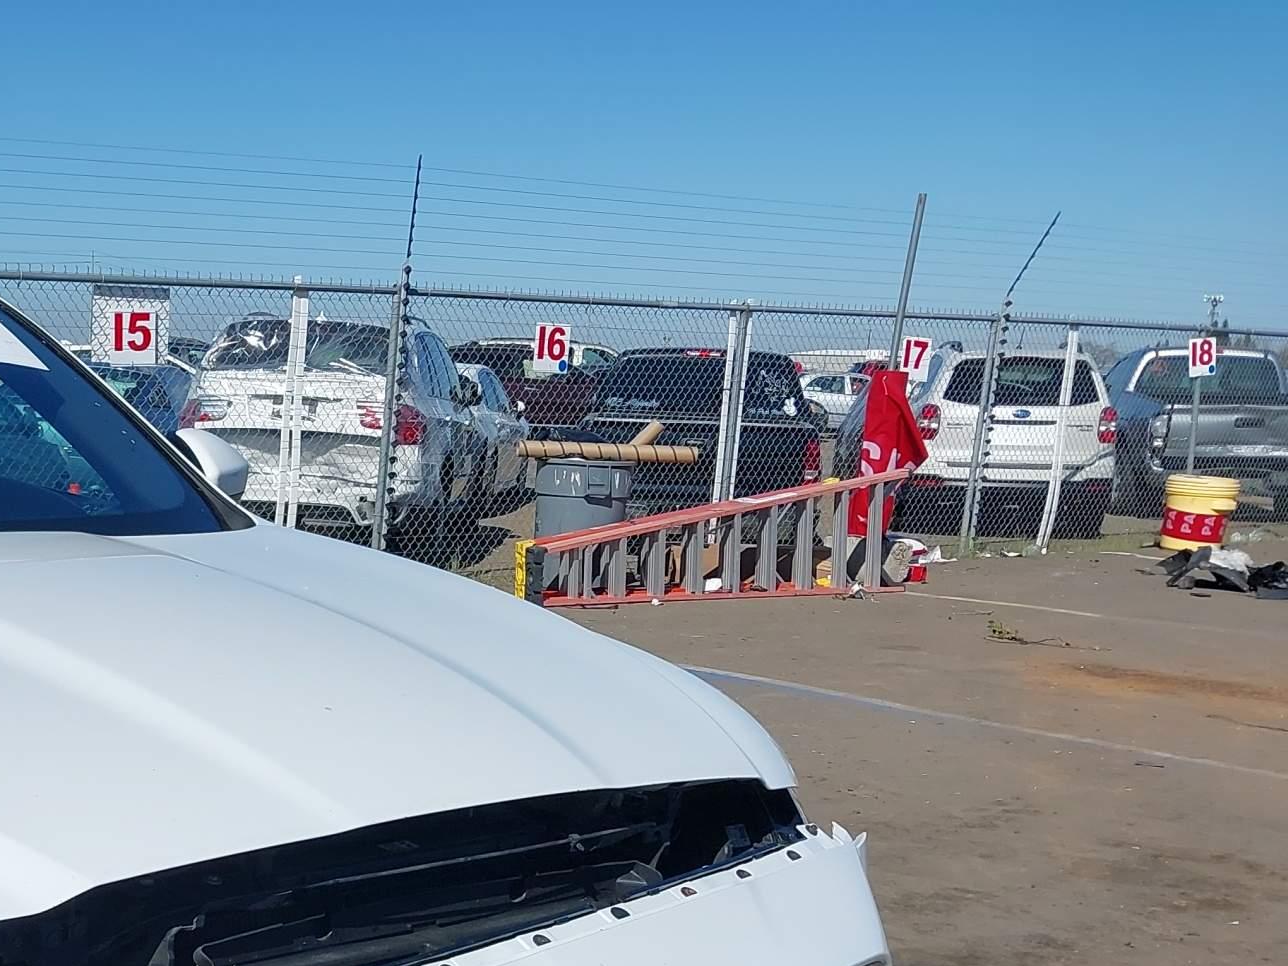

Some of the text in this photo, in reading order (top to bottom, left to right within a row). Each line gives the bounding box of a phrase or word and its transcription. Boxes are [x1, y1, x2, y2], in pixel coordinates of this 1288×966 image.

[114, 312, 152, 352] 15
[537, 326, 566, 361] 16
[903, 339, 929, 369] 17
[1192, 339, 1213, 367] 18
[1180, 514, 1197, 534] PA
[1201, 516, 1217, 536] PA
